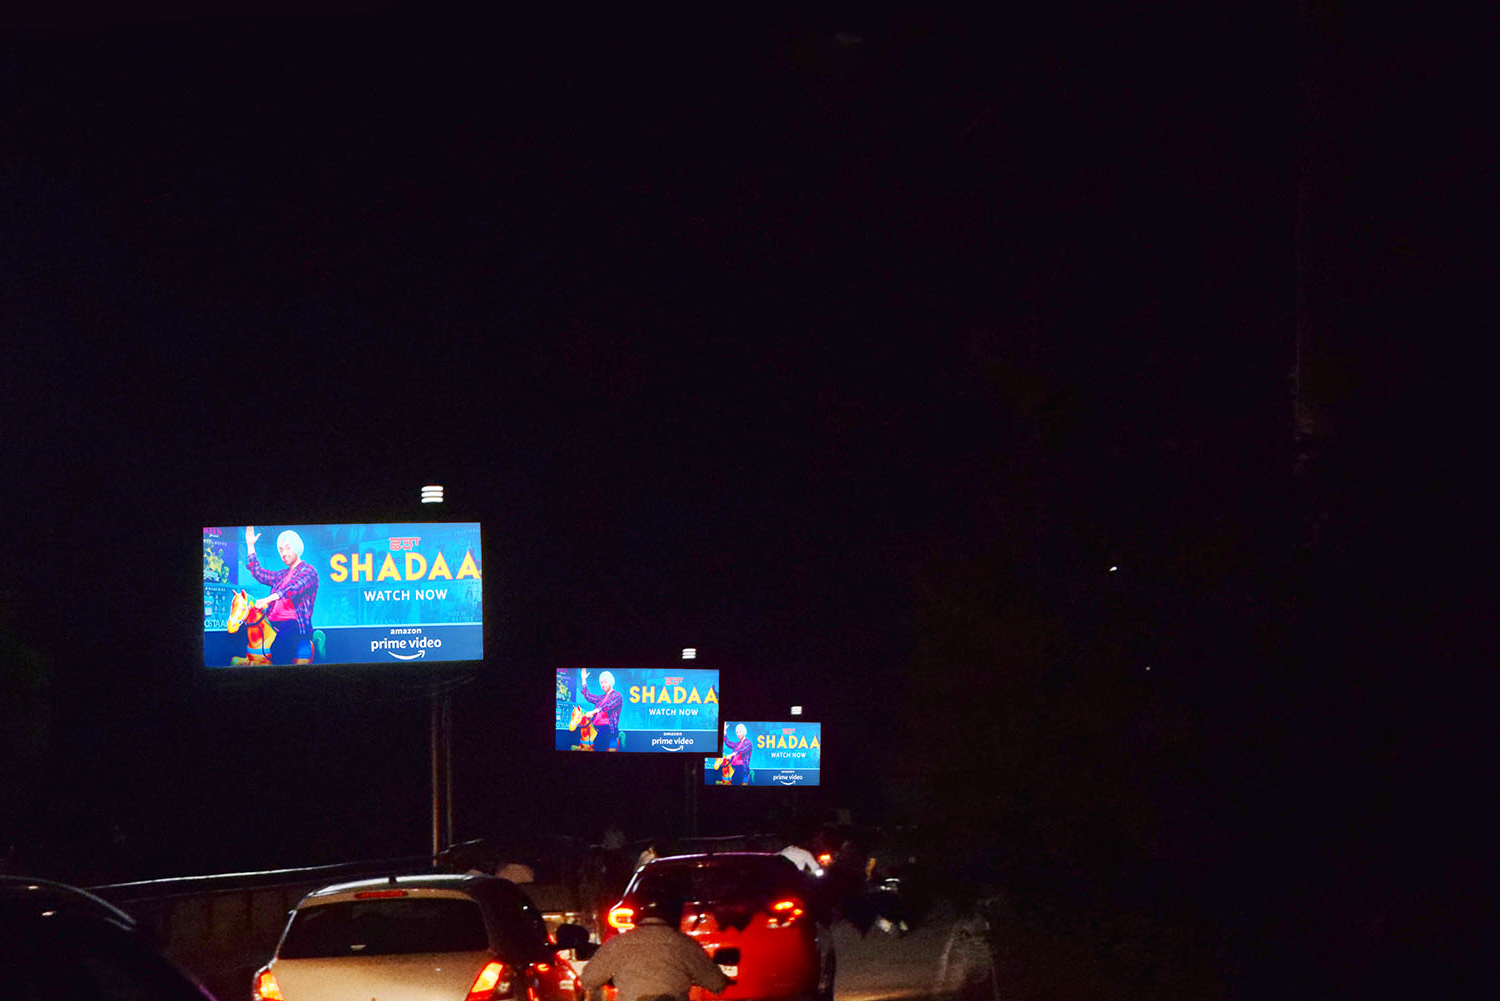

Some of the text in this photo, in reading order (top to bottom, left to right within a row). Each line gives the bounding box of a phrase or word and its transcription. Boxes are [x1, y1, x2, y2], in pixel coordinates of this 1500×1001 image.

[329, 551, 482, 583] SHADAA
[364, 589, 448, 602] WATCH NOW
[371, 637, 442, 652] prime video
[629, 685, 719, 704] SHADAA
[649, 708, 699, 716] WATCH NOW
[651, 737, 694, 746] prime video
[757, 734, 820, 749] SHADAA
